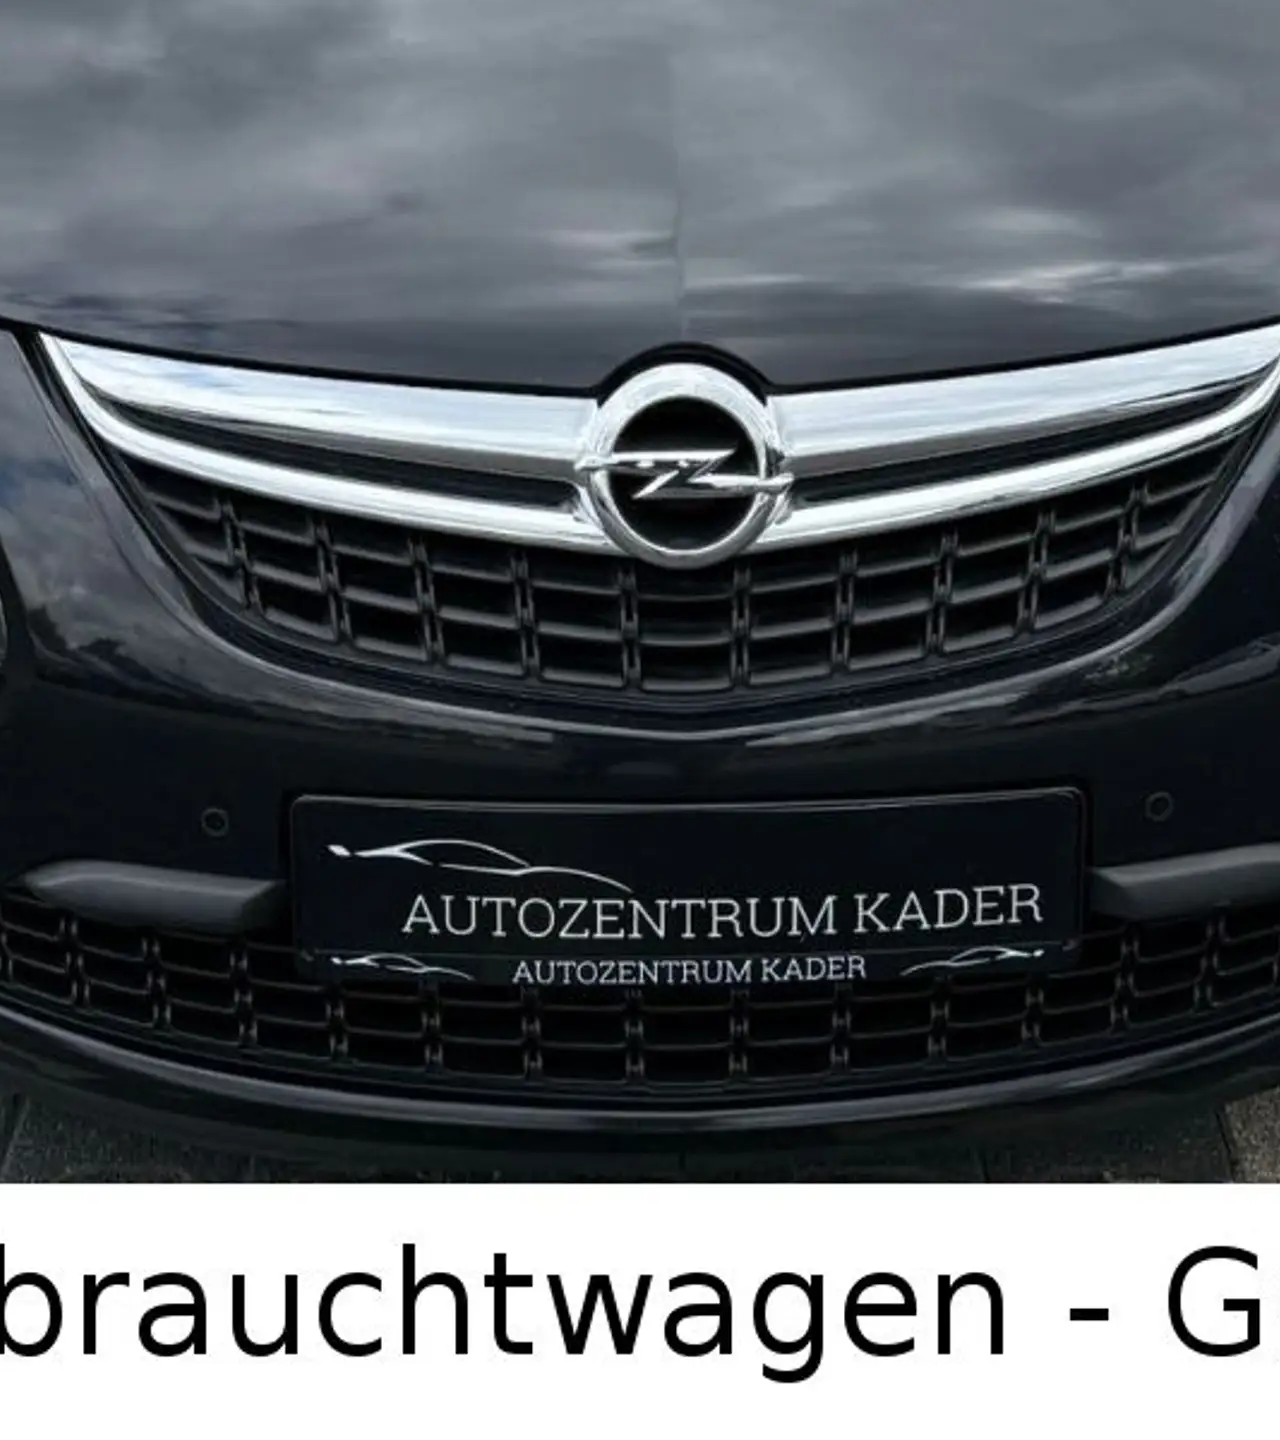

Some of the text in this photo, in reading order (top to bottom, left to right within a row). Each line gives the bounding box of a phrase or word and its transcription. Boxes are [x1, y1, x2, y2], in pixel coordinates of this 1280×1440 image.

[401, 883, 1045, 940] AUTOZENTRUM KADER
[512, 955, 866, 986] AUTOZENTRUM KADER
